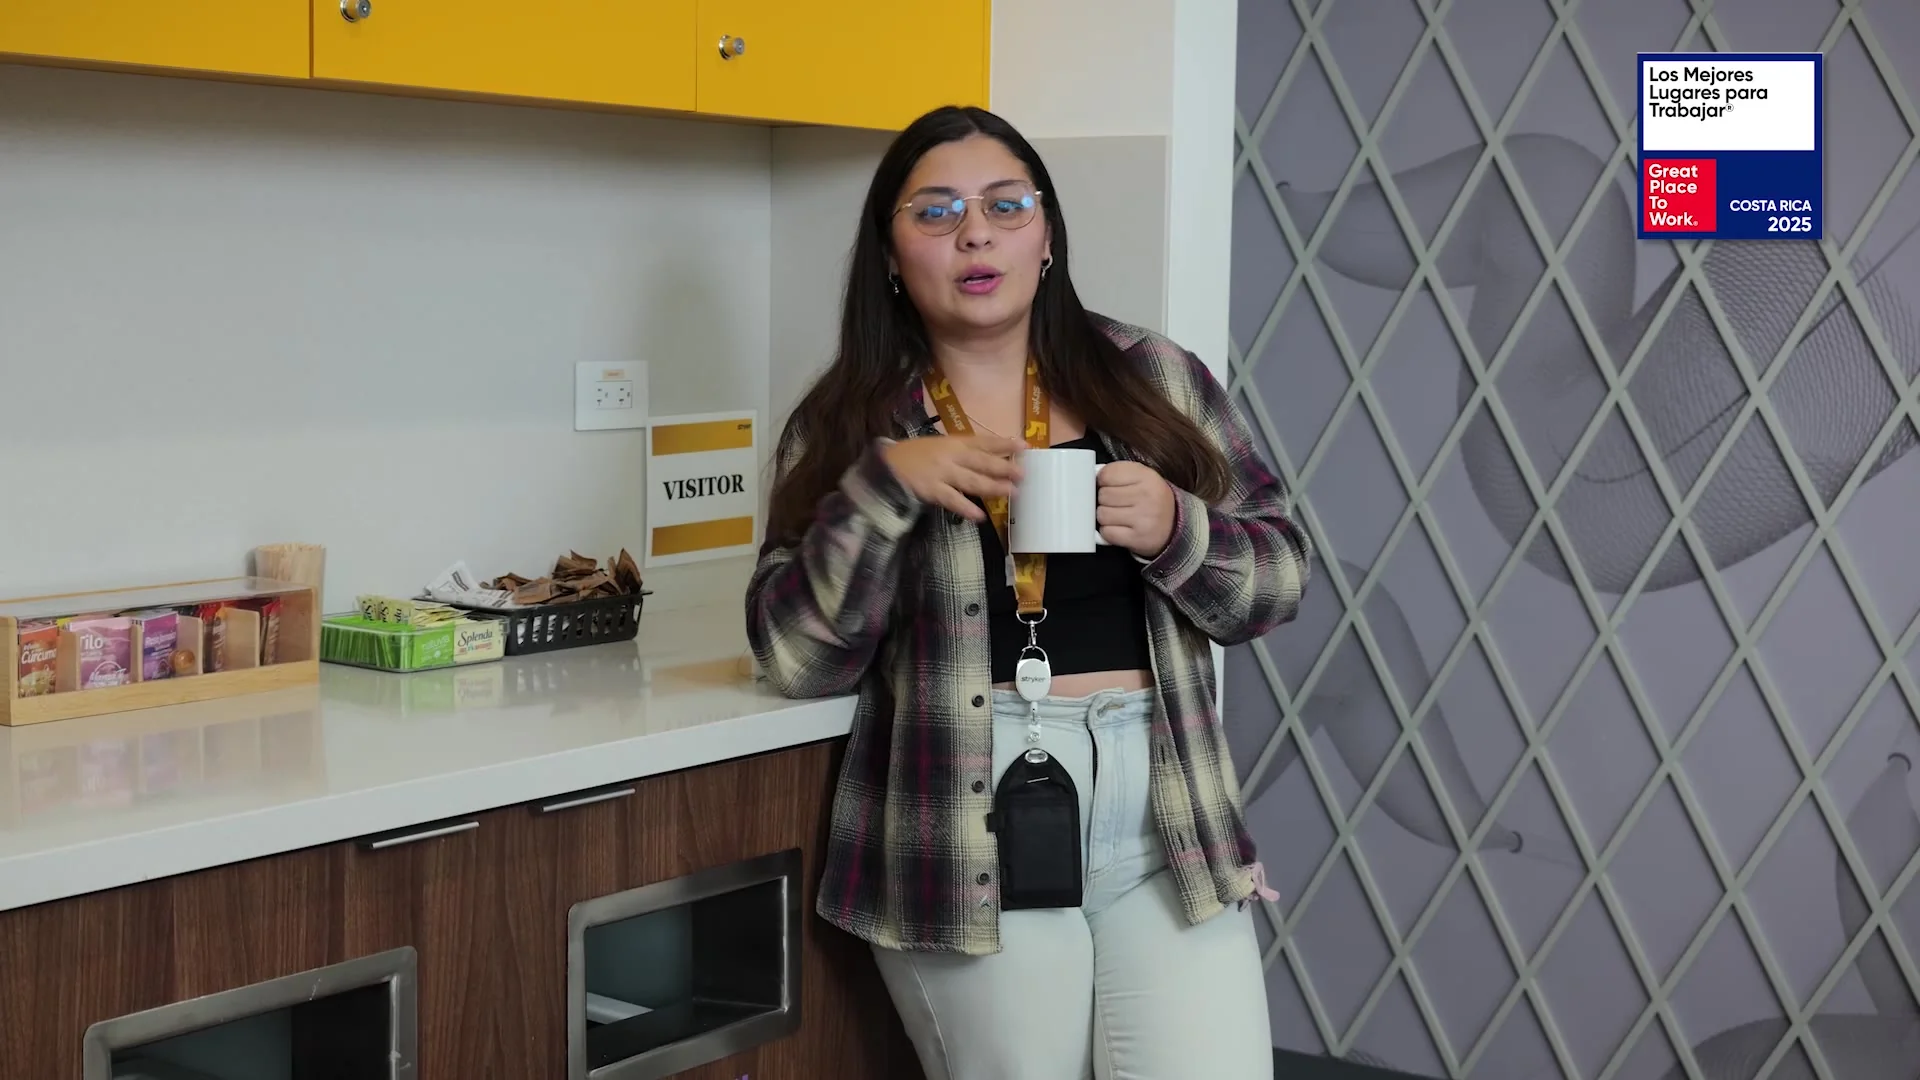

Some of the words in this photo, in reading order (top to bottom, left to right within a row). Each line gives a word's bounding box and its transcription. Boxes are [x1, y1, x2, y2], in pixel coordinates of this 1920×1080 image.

[1031, 385, 1041, 416] stryker
[662, 473, 745, 501] VISITOR
[457, 628, 494, 648] Splenda
[1020, 675, 1046, 684] stryker
